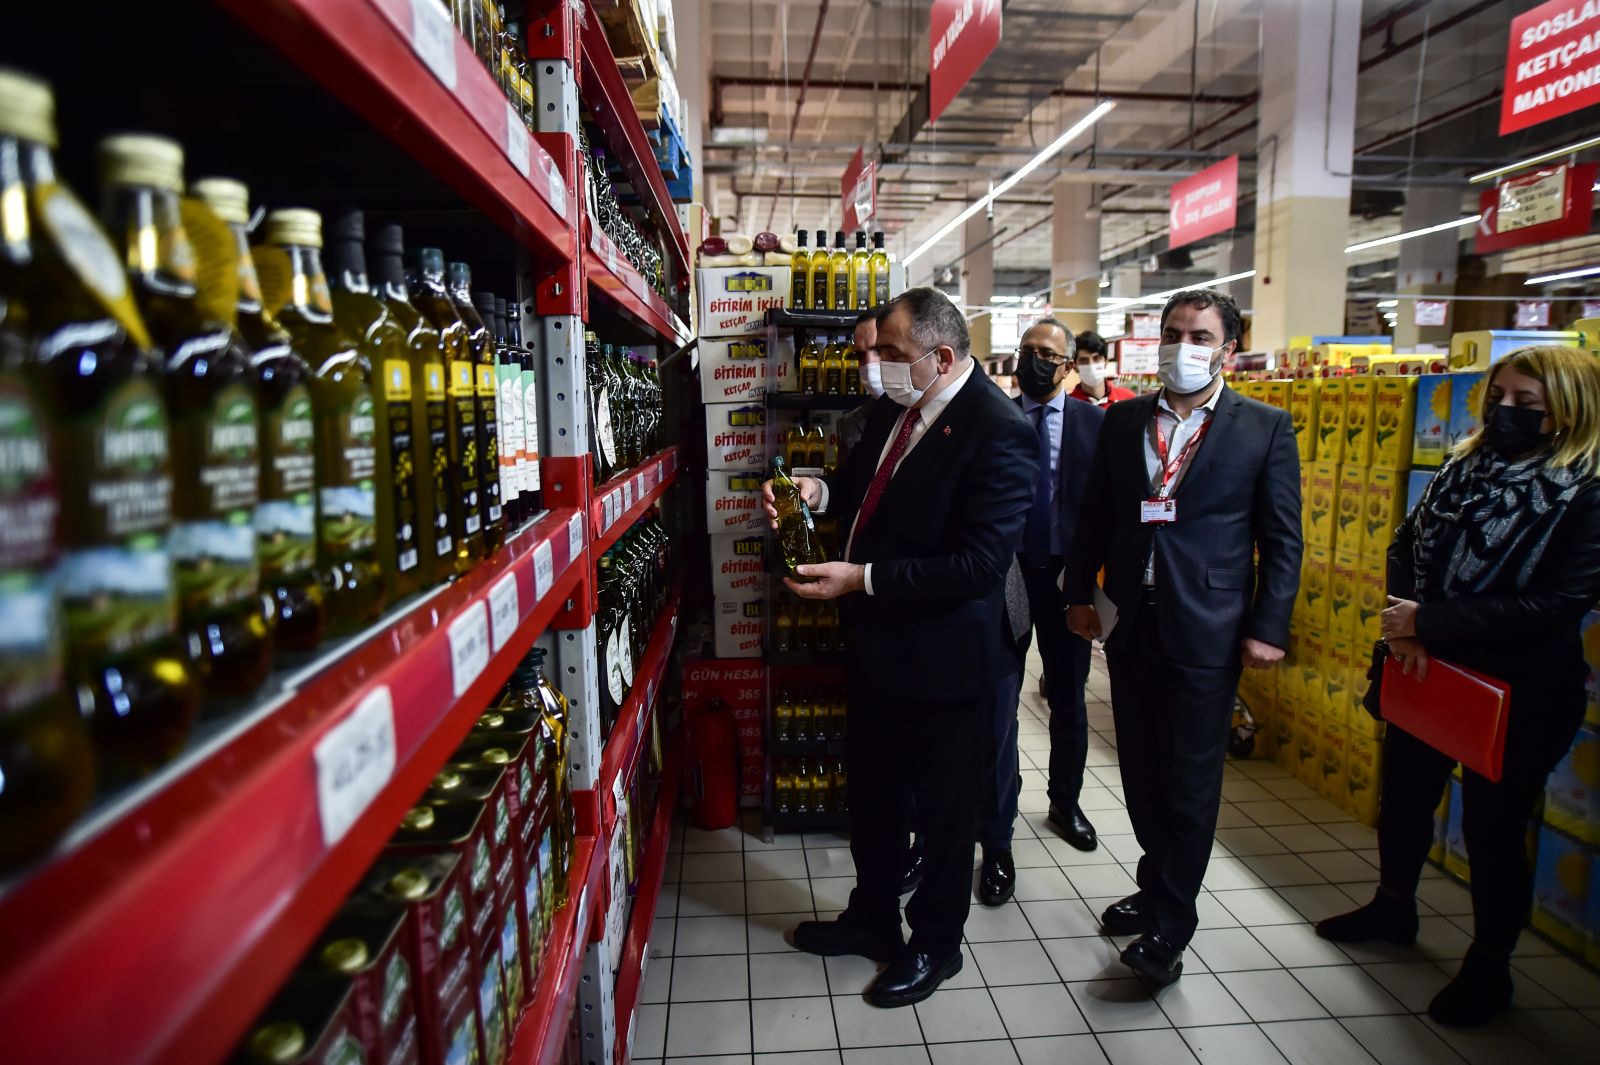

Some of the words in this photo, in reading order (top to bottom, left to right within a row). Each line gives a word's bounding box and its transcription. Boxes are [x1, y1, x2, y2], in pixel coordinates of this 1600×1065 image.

[710, 298, 753, 313] BİTİRİM
[720, 315, 748, 330] KETÇAP
[714, 364, 756, 380] BİTİRİM
[724, 381, 752, 397] KETÇAP
[714, 432, 756, 447] BİTİRİM
[724, 449, 751, 463] KETÇAP
[715, 496, 756, 511] BİTİRİM
[724, 513, 751, 527] KETÇAP
